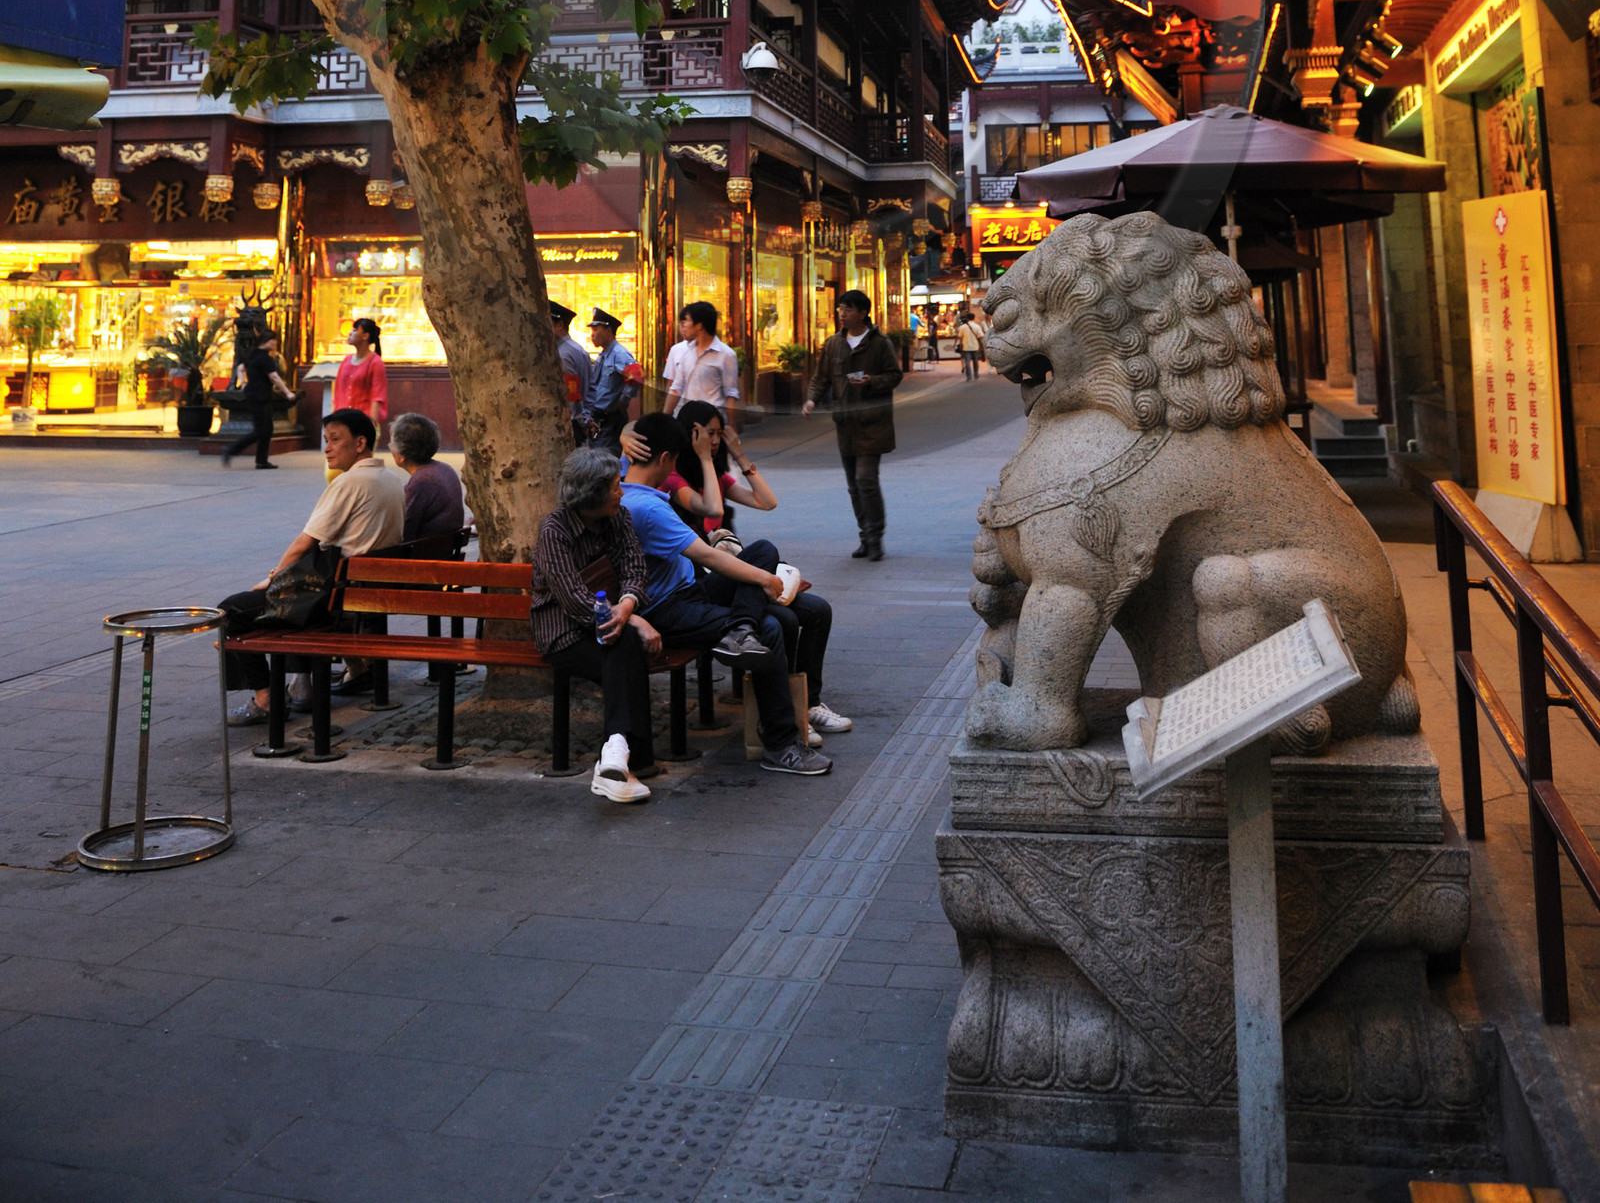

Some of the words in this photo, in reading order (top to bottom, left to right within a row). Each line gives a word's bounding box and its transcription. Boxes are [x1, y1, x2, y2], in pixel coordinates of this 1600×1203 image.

[982, 219, 1055, 244] 老邻居
[541, 248, 573, 262] Miao
[574, 247, 619, 263] Jewelry
[1520, 255, 1540, 461] 汇集上海名老中医专家
